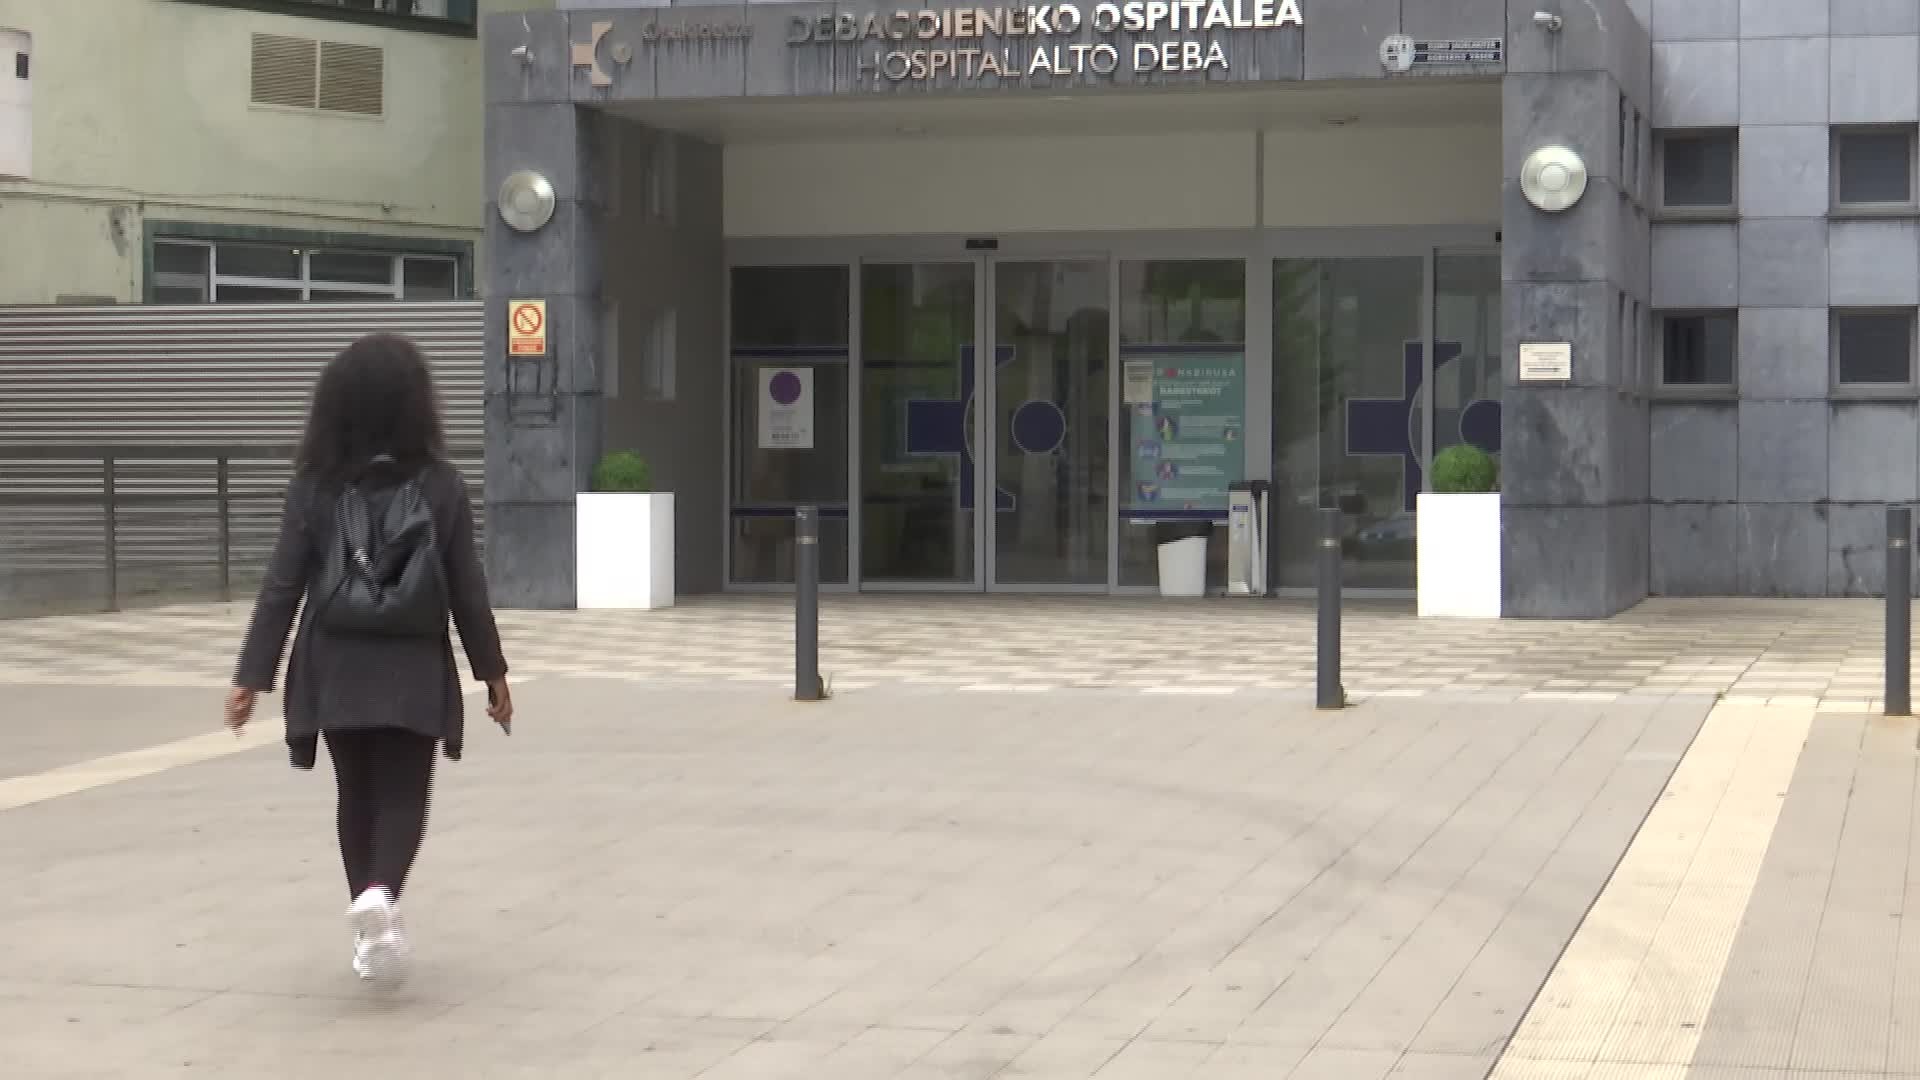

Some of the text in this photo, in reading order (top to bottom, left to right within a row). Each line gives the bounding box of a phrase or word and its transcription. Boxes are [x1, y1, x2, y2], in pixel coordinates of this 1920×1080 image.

[1091, 0, 1304, 32] OSPITALEA
[857, 40, 1229, 80] HOSPITAL ALTO DEBA
